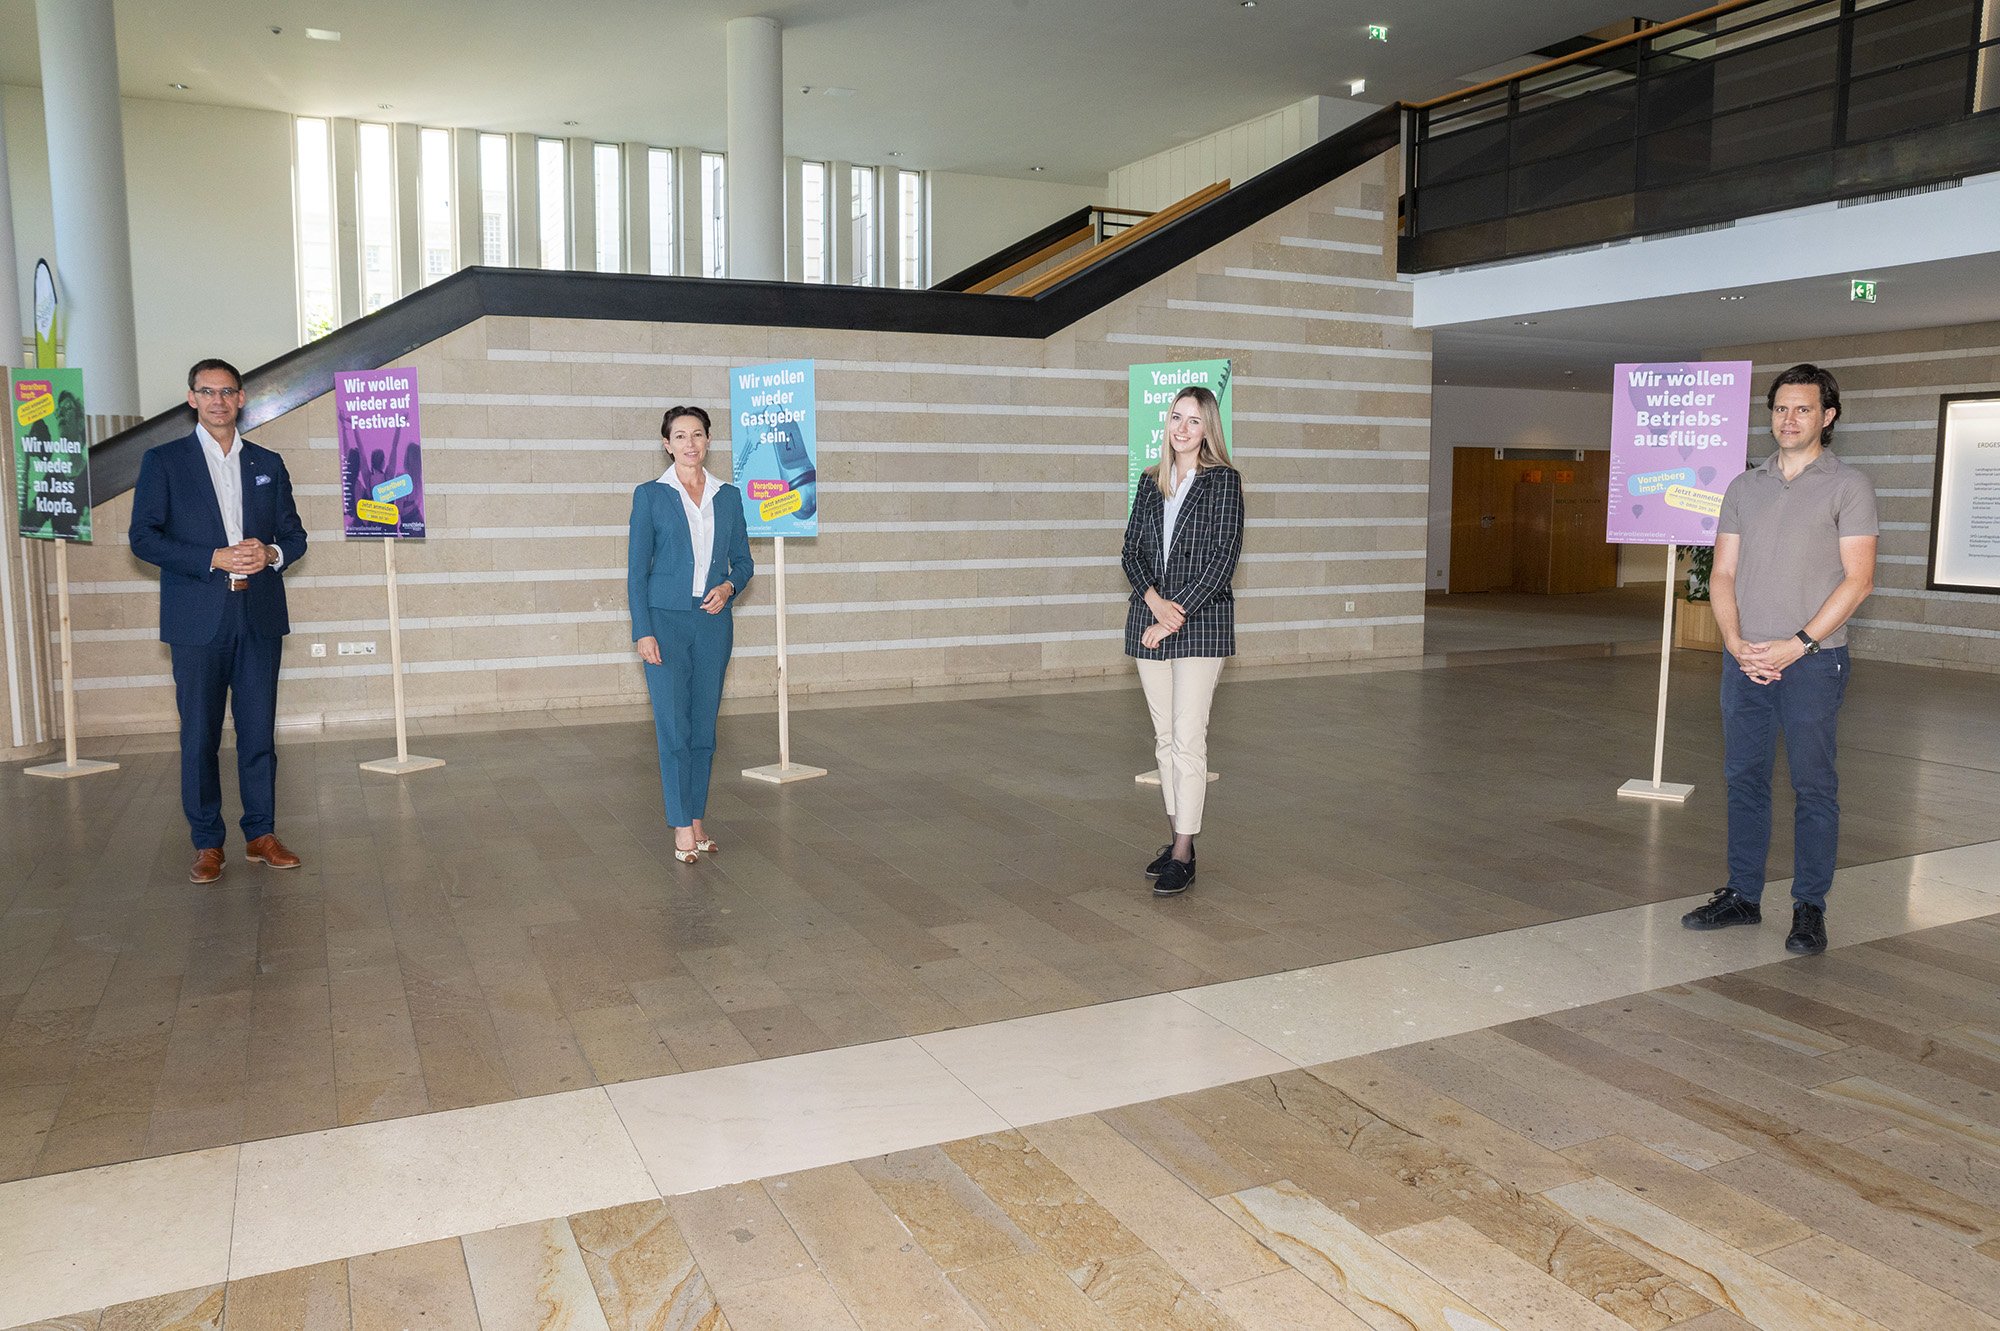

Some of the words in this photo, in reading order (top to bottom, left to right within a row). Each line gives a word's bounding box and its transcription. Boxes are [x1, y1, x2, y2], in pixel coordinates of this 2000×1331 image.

[344, 378, 366, 394] Wir
[367, 376, 409, 392] wollen
[739, 374, 760, 390] Wir
[763, 370, 805, 387] wollen
[1150, 369, 1208, 386] Yeniden
[1629, 370, 1667, 387] Wir
[1667, 370, 1735, 386] wollen
[345, 396, 387, 412] wieder
[390, 394, 410, 409] auf
[751, 391, 794, 407] wieder
[1646, 390, 1715, 407] wieder
[351, 413, 410, 430] Festivals.
[741, 409, 806, 428] Gastgeber
[1636, 410, 1729, 427] Betriebs-
[760, 428, 790, 444] sein.
[1634, 430, 1728, 450] ausflüge.
[21, 436, 42, 454] Wir
[44, 437, 81, 454] wollen
[33, 457, 73, 474] wieder
[33, 480, 48, 493] an
[49, 477, 75, 494] Jass
[377, 479, 406, 494] Vorarlberg
[752, 482, 783, 492] Vorarlberg
[1637, 472, 1686, 485] Vorarlberg
[1639, 480, 1667, 494] impft.
[1674, 487, 1692, 498] Jetzt
[1692, 490, 1722, 504] anmelde
[36, 497, 78, 517] klopfa.
